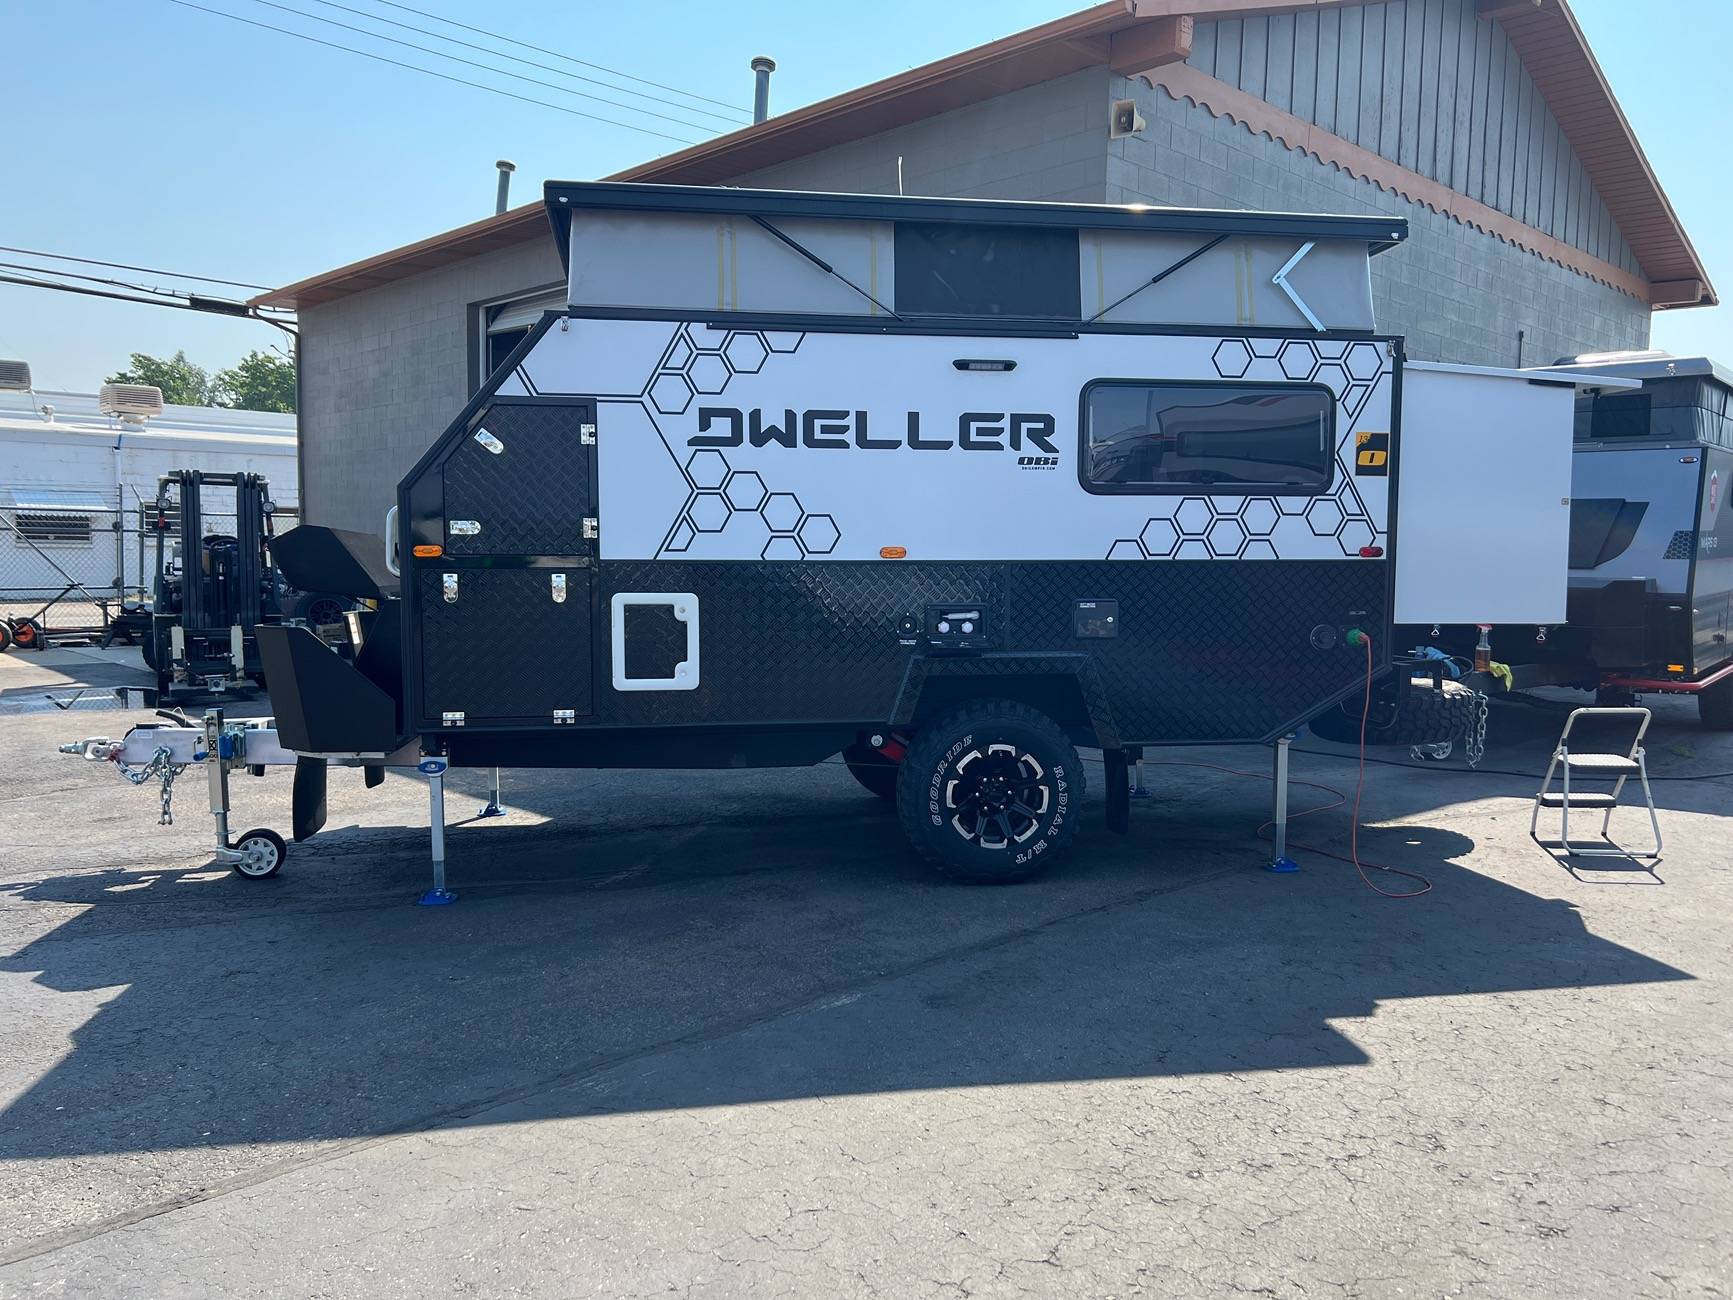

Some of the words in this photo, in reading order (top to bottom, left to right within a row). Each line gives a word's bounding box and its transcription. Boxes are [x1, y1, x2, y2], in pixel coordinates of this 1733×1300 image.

[687, 407, 1060, 454] DWELLER
[929, 734, 973, 826] GOODRIDE
[1047, 765, 1068, 837] RADIAL
